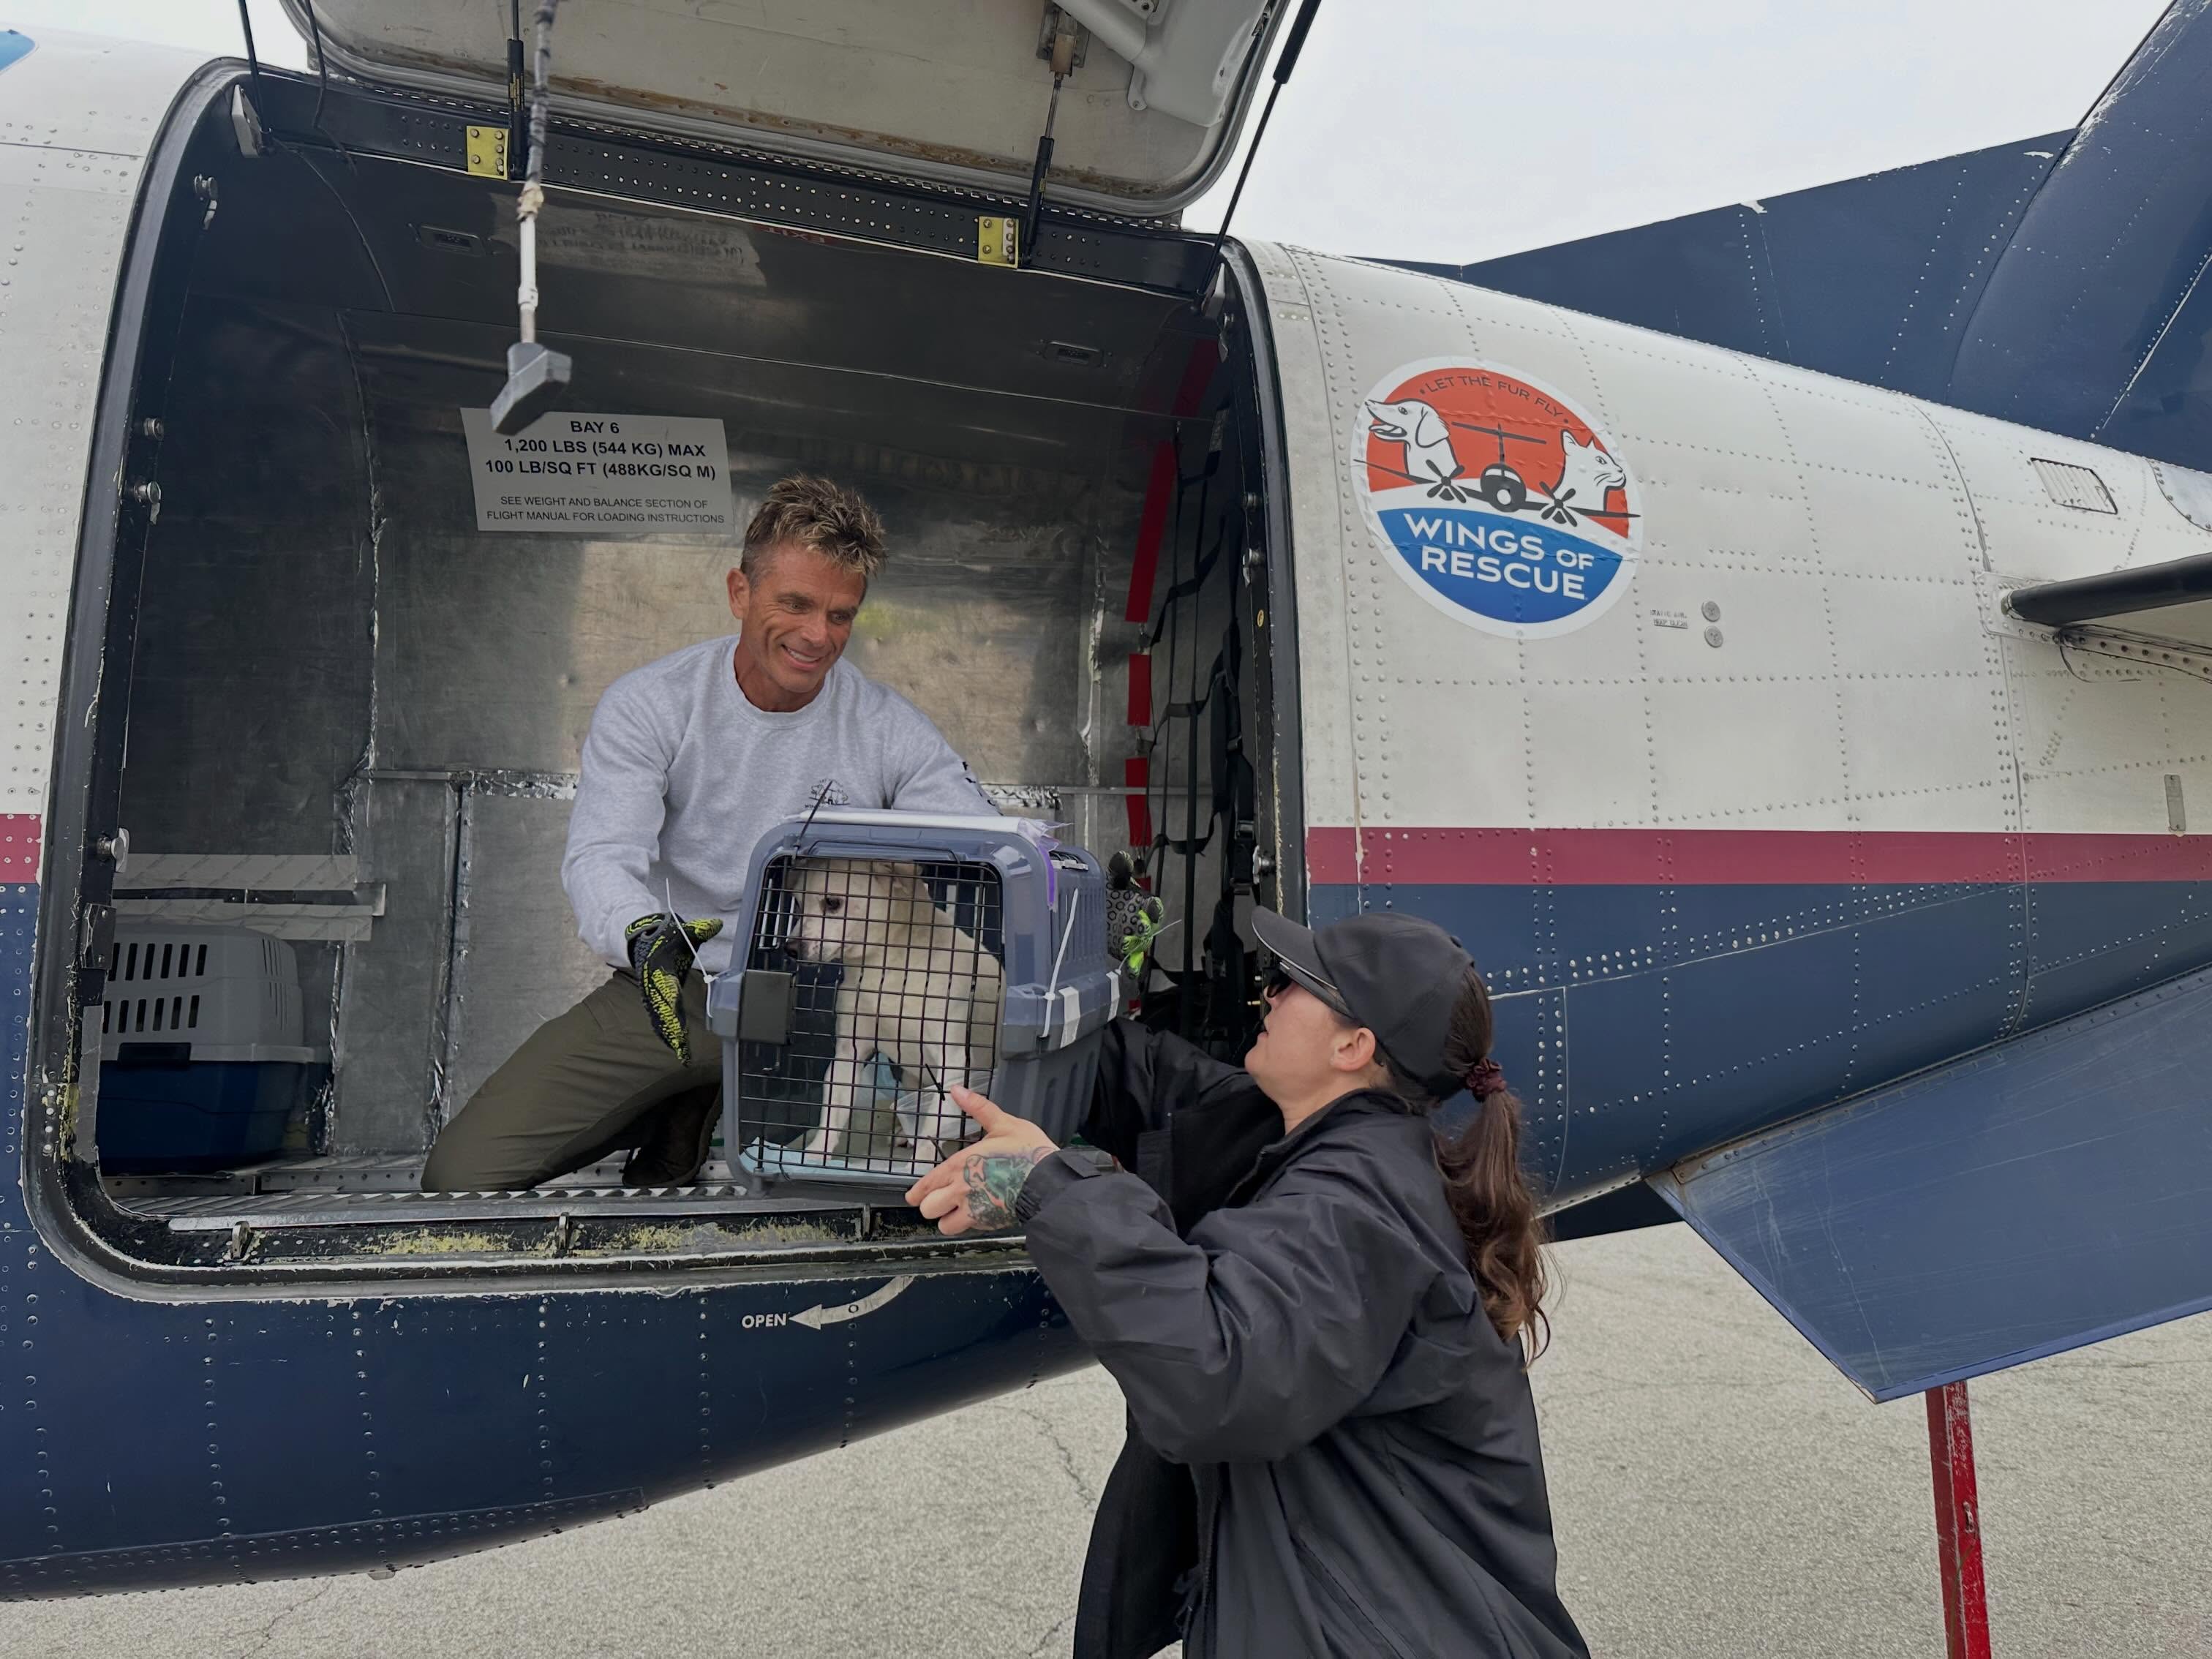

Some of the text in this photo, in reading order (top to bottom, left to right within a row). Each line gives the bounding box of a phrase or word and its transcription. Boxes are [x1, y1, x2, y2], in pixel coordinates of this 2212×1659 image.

[1425, 375, 1563, 418] LET THE FUR FLY
[570, 421, 620, 434] BAY 6
[504, 438, 707, 459] 1,200 LBS (544 KG) MAX
[485, 459, 716, 481] 100 LB/SQ FT (488KG/SQ M)
[500, 496, 709, 509] SEE WEIGHT AND BALANCE SECTION OF
[486, 510, 725, 524] FLIGHT MANUAL FOR LOADING INSTRUCTIONS
[1403, 513, 1595, 571] WINGS OF
[1421, 545, 1587, 600] RESCUE
[741, 1313, 786, 1328] OPEN
